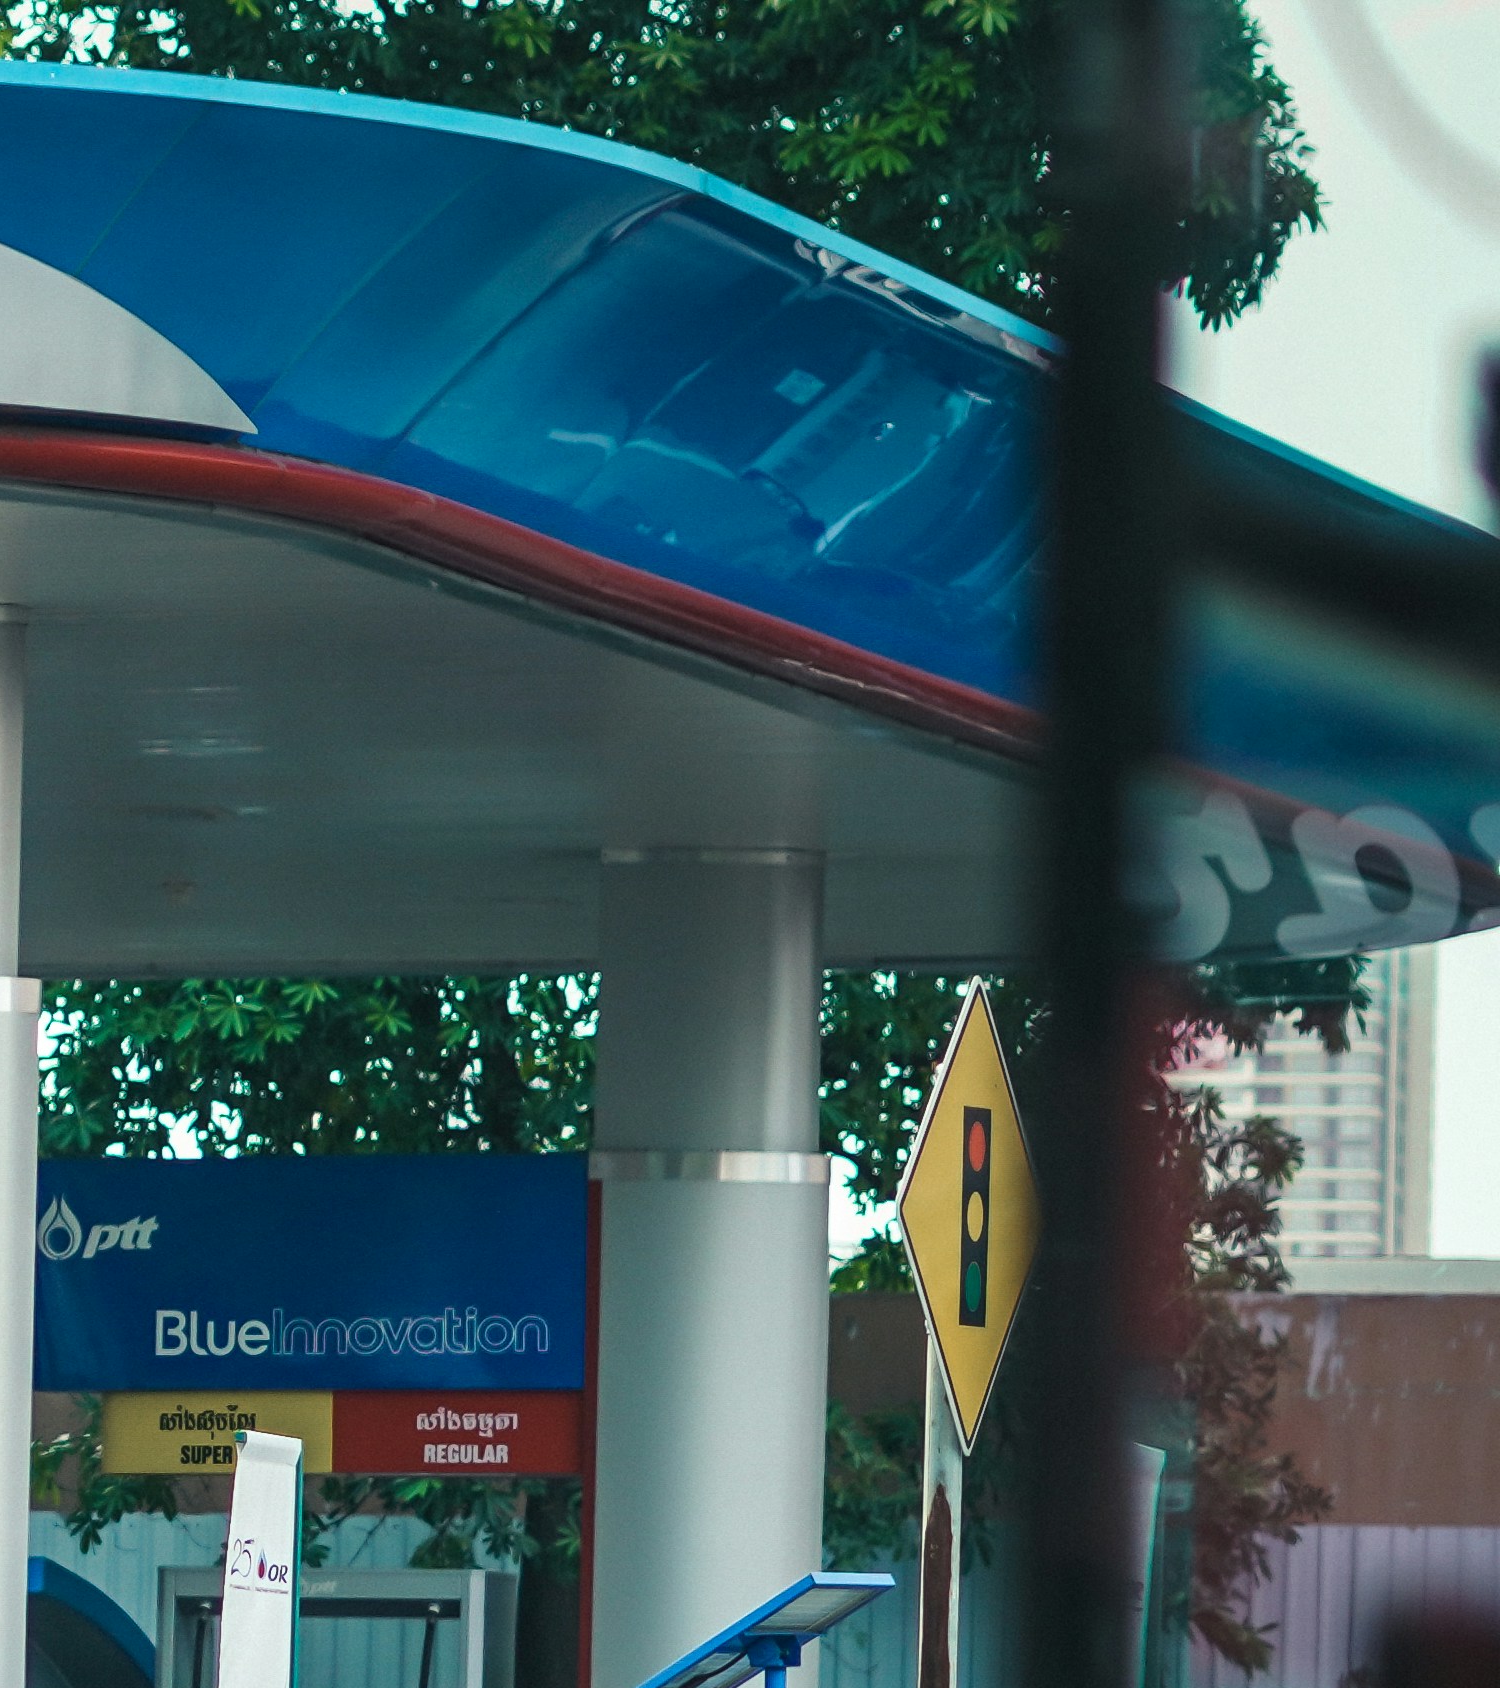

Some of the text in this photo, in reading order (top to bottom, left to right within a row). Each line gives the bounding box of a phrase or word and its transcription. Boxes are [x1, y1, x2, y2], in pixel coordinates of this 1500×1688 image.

[82, 1215, 159, 1258] ptt
[155, 1306, 550, 1356] BlueInnovation
[180, 1446, 234, 1464] SUPER
[423, 1445, 509, 1463] REGULAR
[230, 1538, 289, 1583] 25 OR
